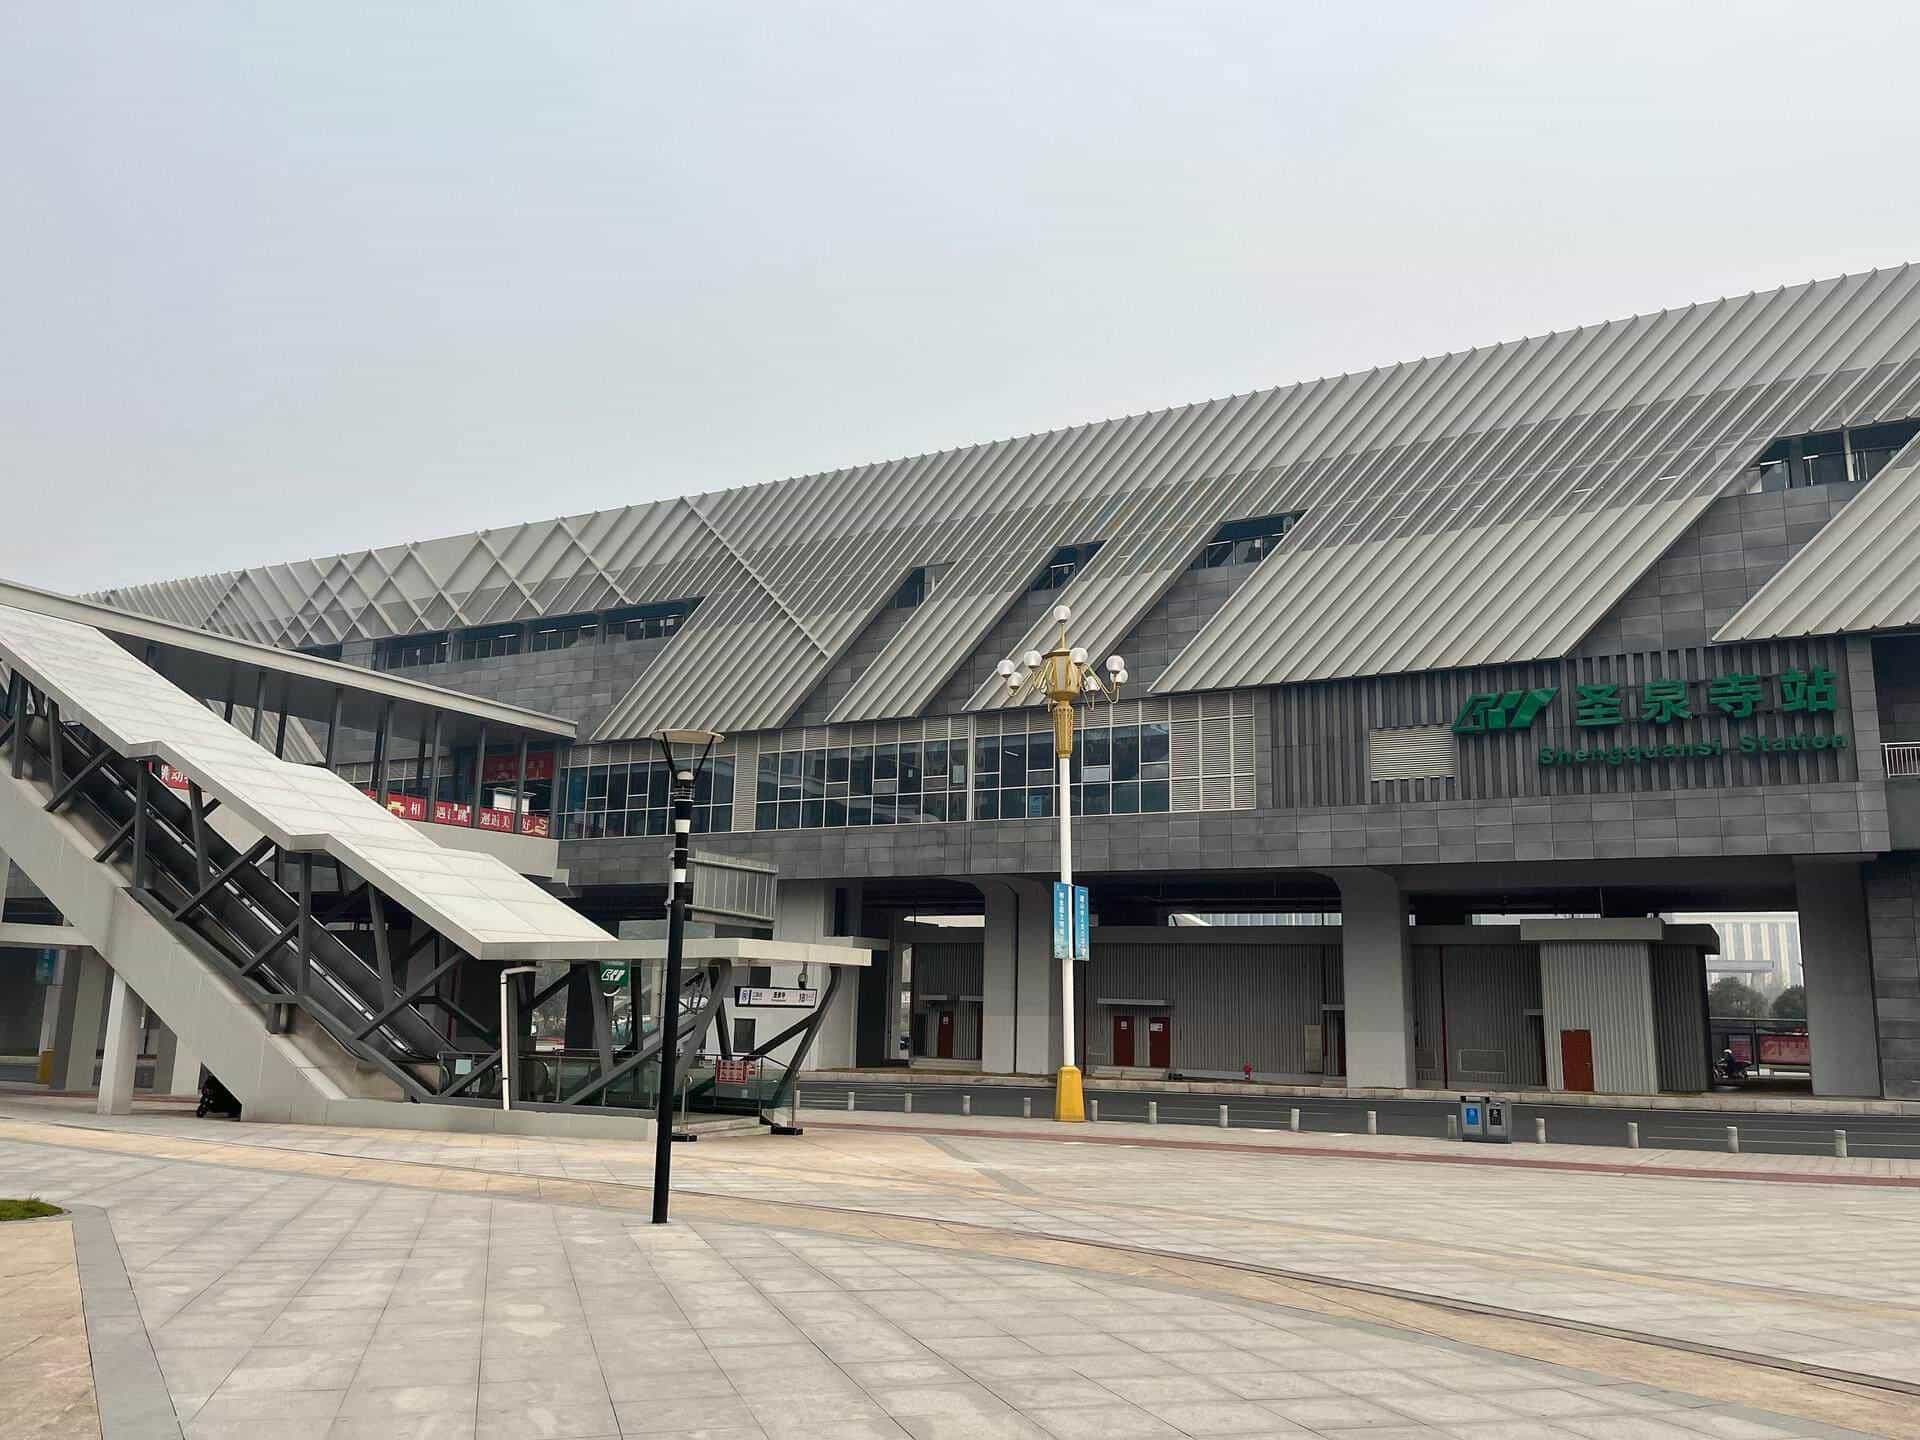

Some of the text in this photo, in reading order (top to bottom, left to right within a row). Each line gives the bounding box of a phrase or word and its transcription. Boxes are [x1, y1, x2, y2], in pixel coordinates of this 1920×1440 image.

[1576, 665, 1838, 728] 圣泉寺站
[1539, 732, 1849, 766] Shengquansi Station
